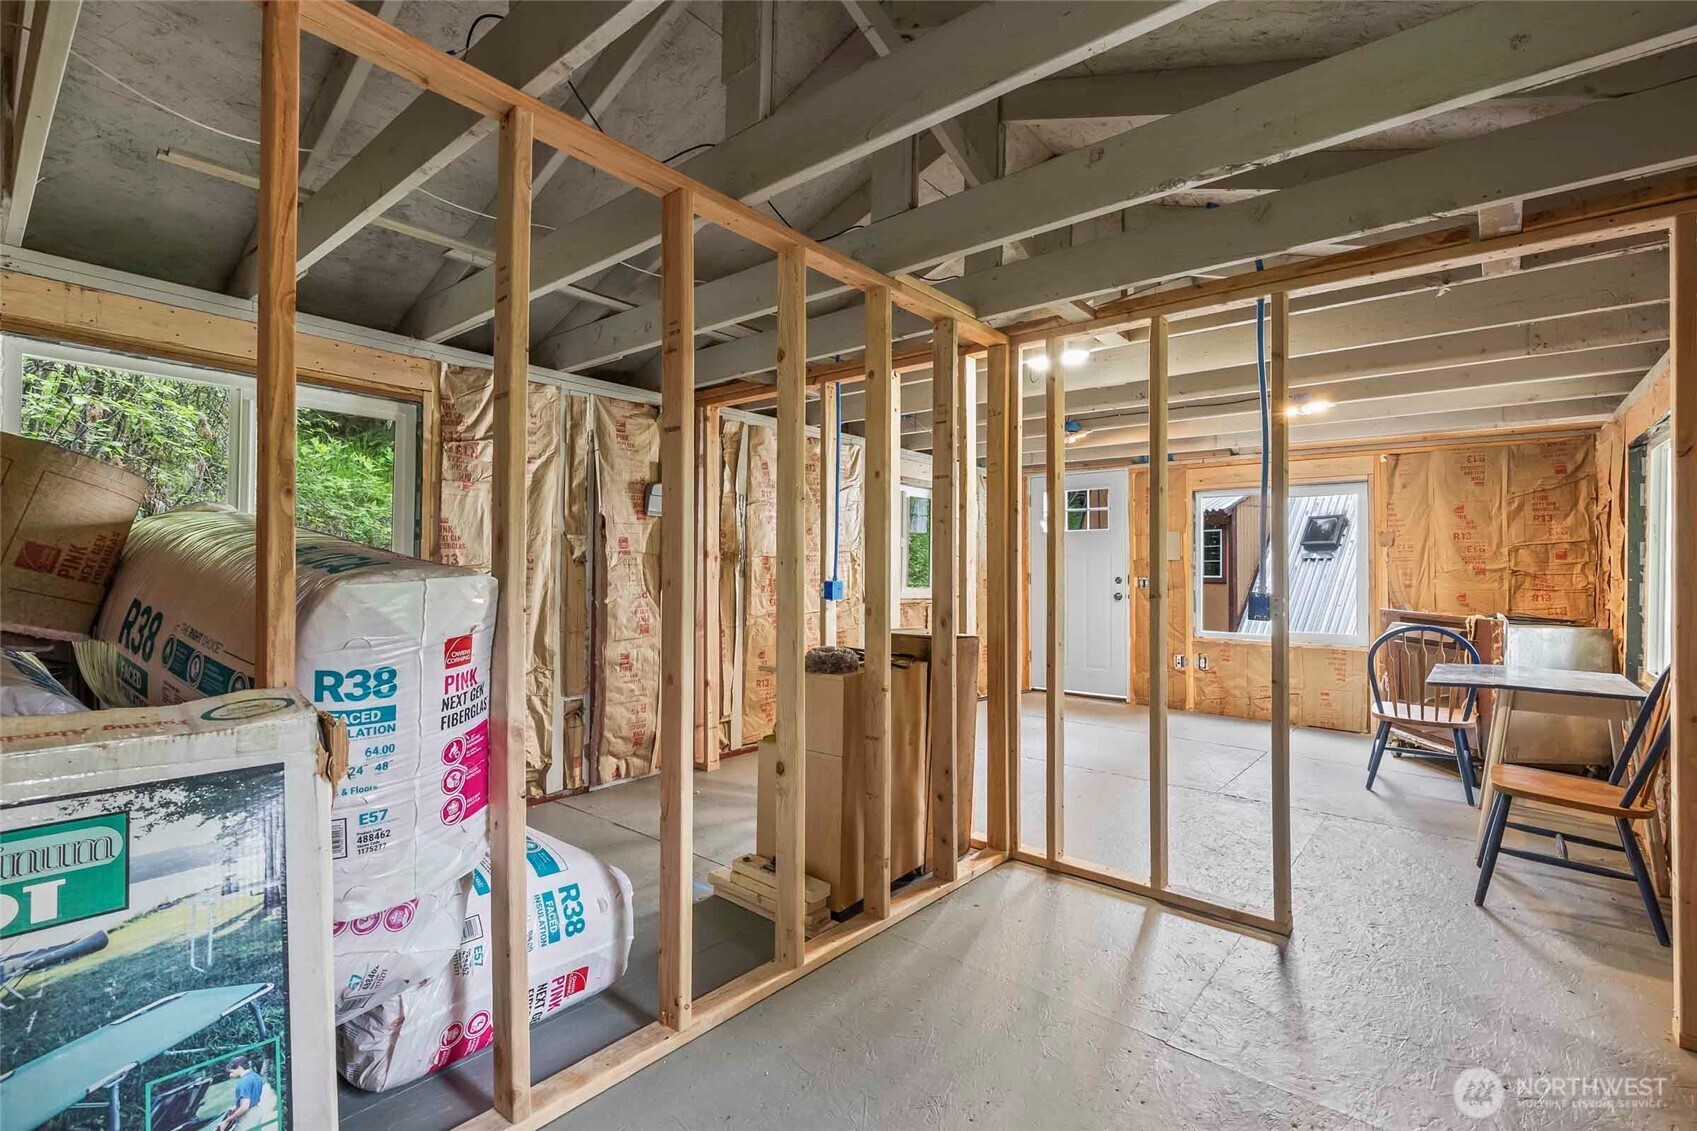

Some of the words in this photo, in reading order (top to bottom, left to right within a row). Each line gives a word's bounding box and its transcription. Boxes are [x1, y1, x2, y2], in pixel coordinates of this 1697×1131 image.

[56, 542, 81, 580] PINK
[118, 597, 164, 662] R38
[446, 654, 471, 664] CORNING
[451, 649, 471, 658] OWENS
[314, 666, 398, 702] R38
[444, 666, 478, 696] PINK
[441, 691, 469, 712] NEXT
[470, 682, 485, 702] GEN
[440, 697, 488, 731] FIBERGLAS
[364, 743, 396, 758] 64.00
[341, 788, 348, 796] &
[358, 808, 389, 826] E57
[356, 829, 391, 844] 488462
[357, 842, 387, 855] 1175277
[533, 893, 548, 948] INSULATION
[545, 899, 558, 934] FACED
[558, 882, 586, 939] R38
[473, 945, 484, 967] E57
[534, 982, 548, 1007] NEXT
[547, 975, 566, 1013] PINK
